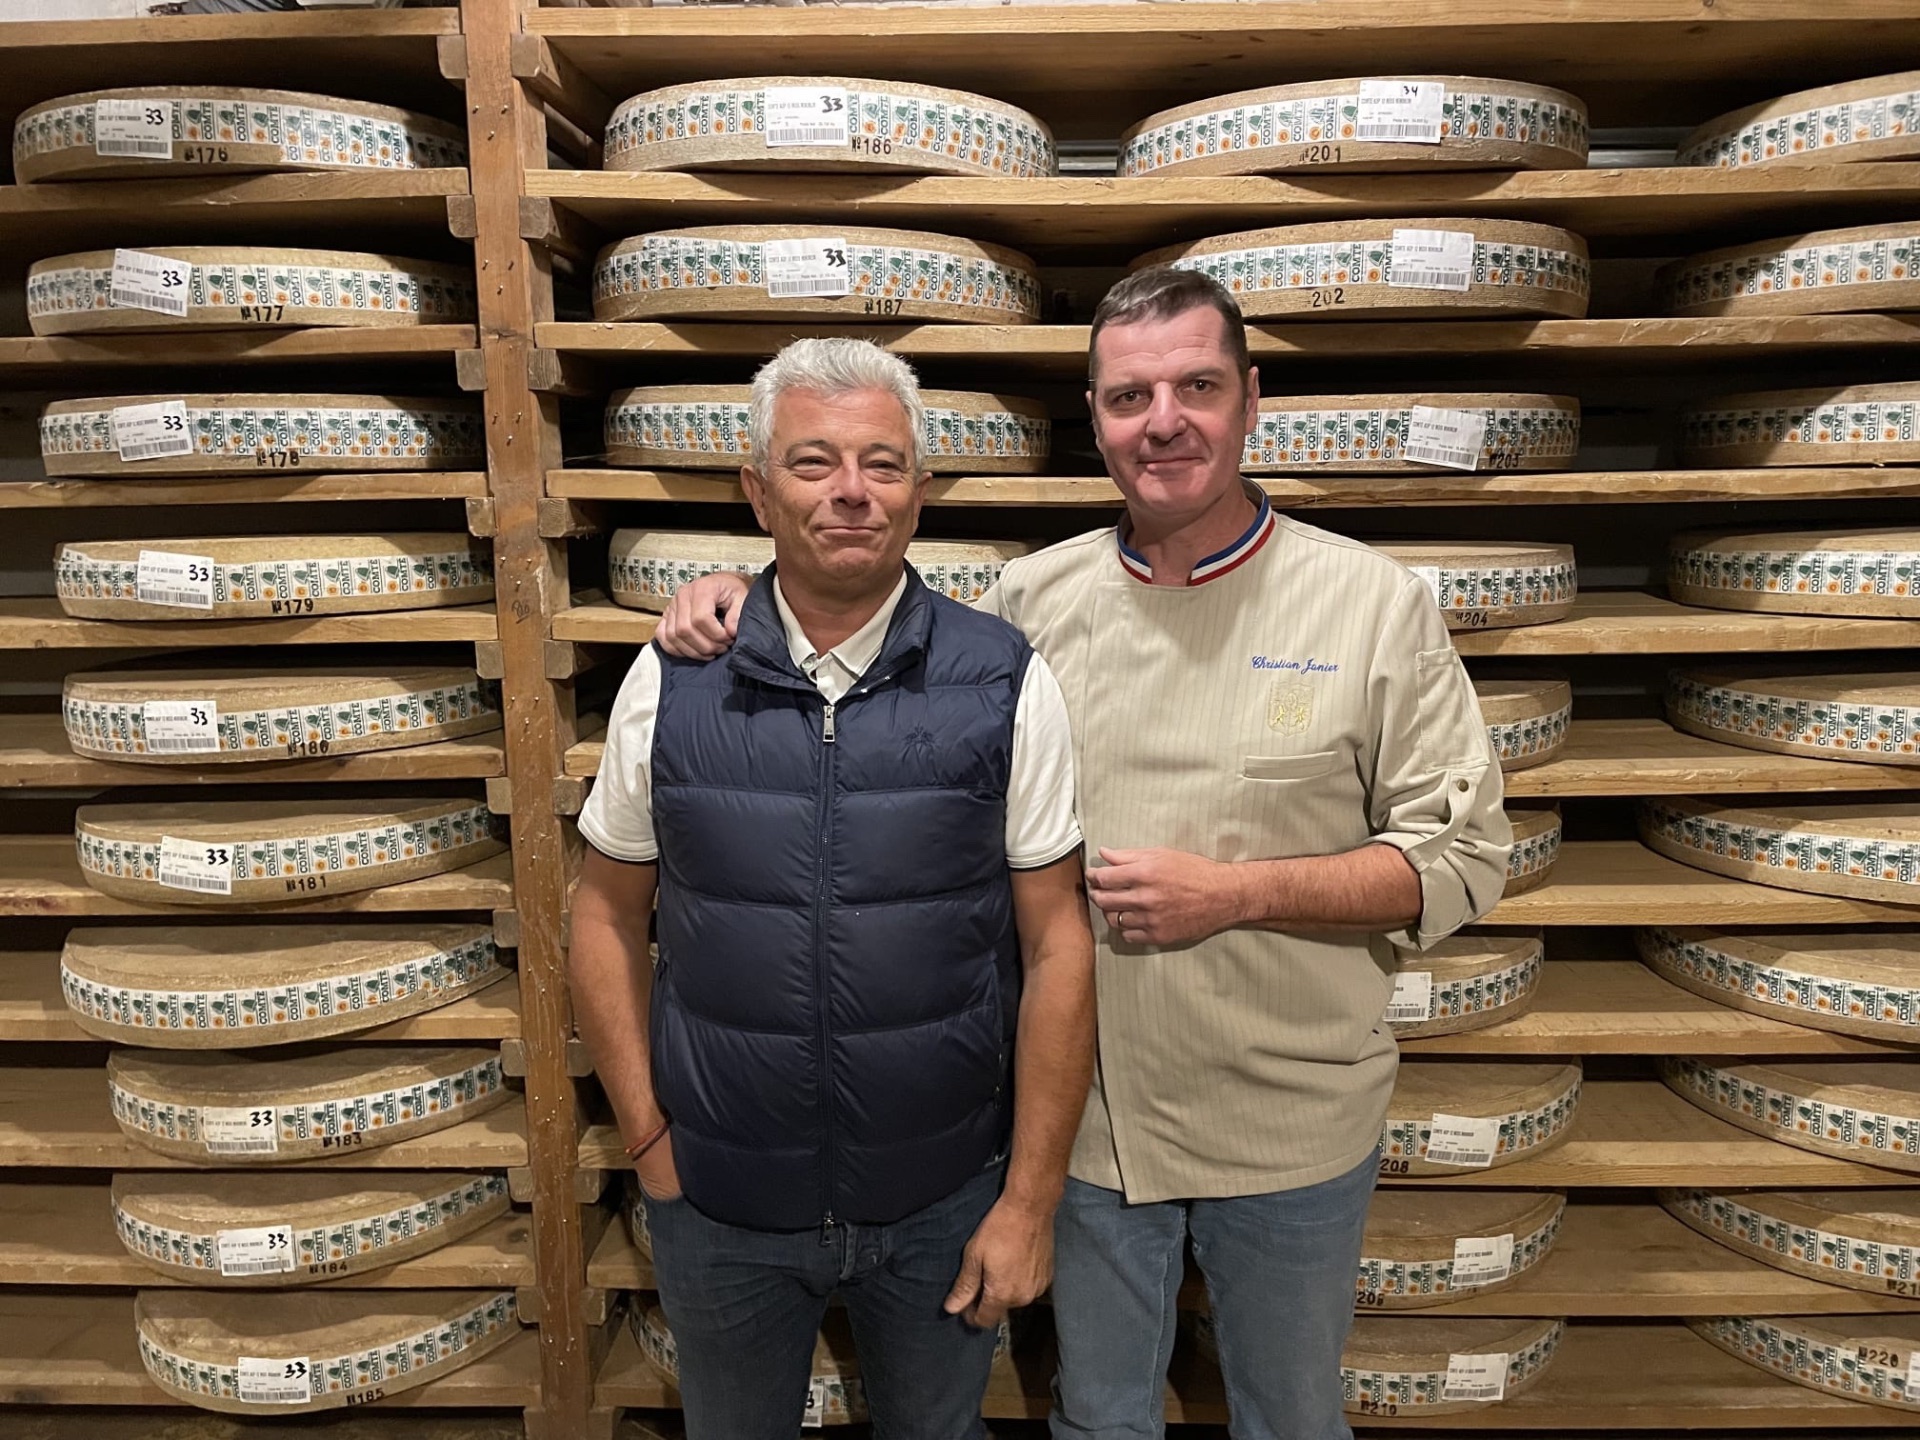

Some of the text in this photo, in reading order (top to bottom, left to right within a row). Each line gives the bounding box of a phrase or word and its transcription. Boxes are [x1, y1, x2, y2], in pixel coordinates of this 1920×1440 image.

[1403, 86, 1418, 98] 34
[820, 95, 843, 113] 33
[146, 108, 164, 125] 33
[823, 249, 846, 266] 33
[161, 270, 181, 286] 33
[1312, 287, 1345, 307] 202
[163, 415, 184, 430] 33
[189, 564, 209, 582] 33
[1252, 656, 1339, 674] Christian Janier
[190, 708, 207, 725] 33
[206, 849, 228, 866] 33
[250, 1110, 273, 1127] 33
[268, 1233, 288, 1249] 33
[284, 1362, 307, 1379] 33
